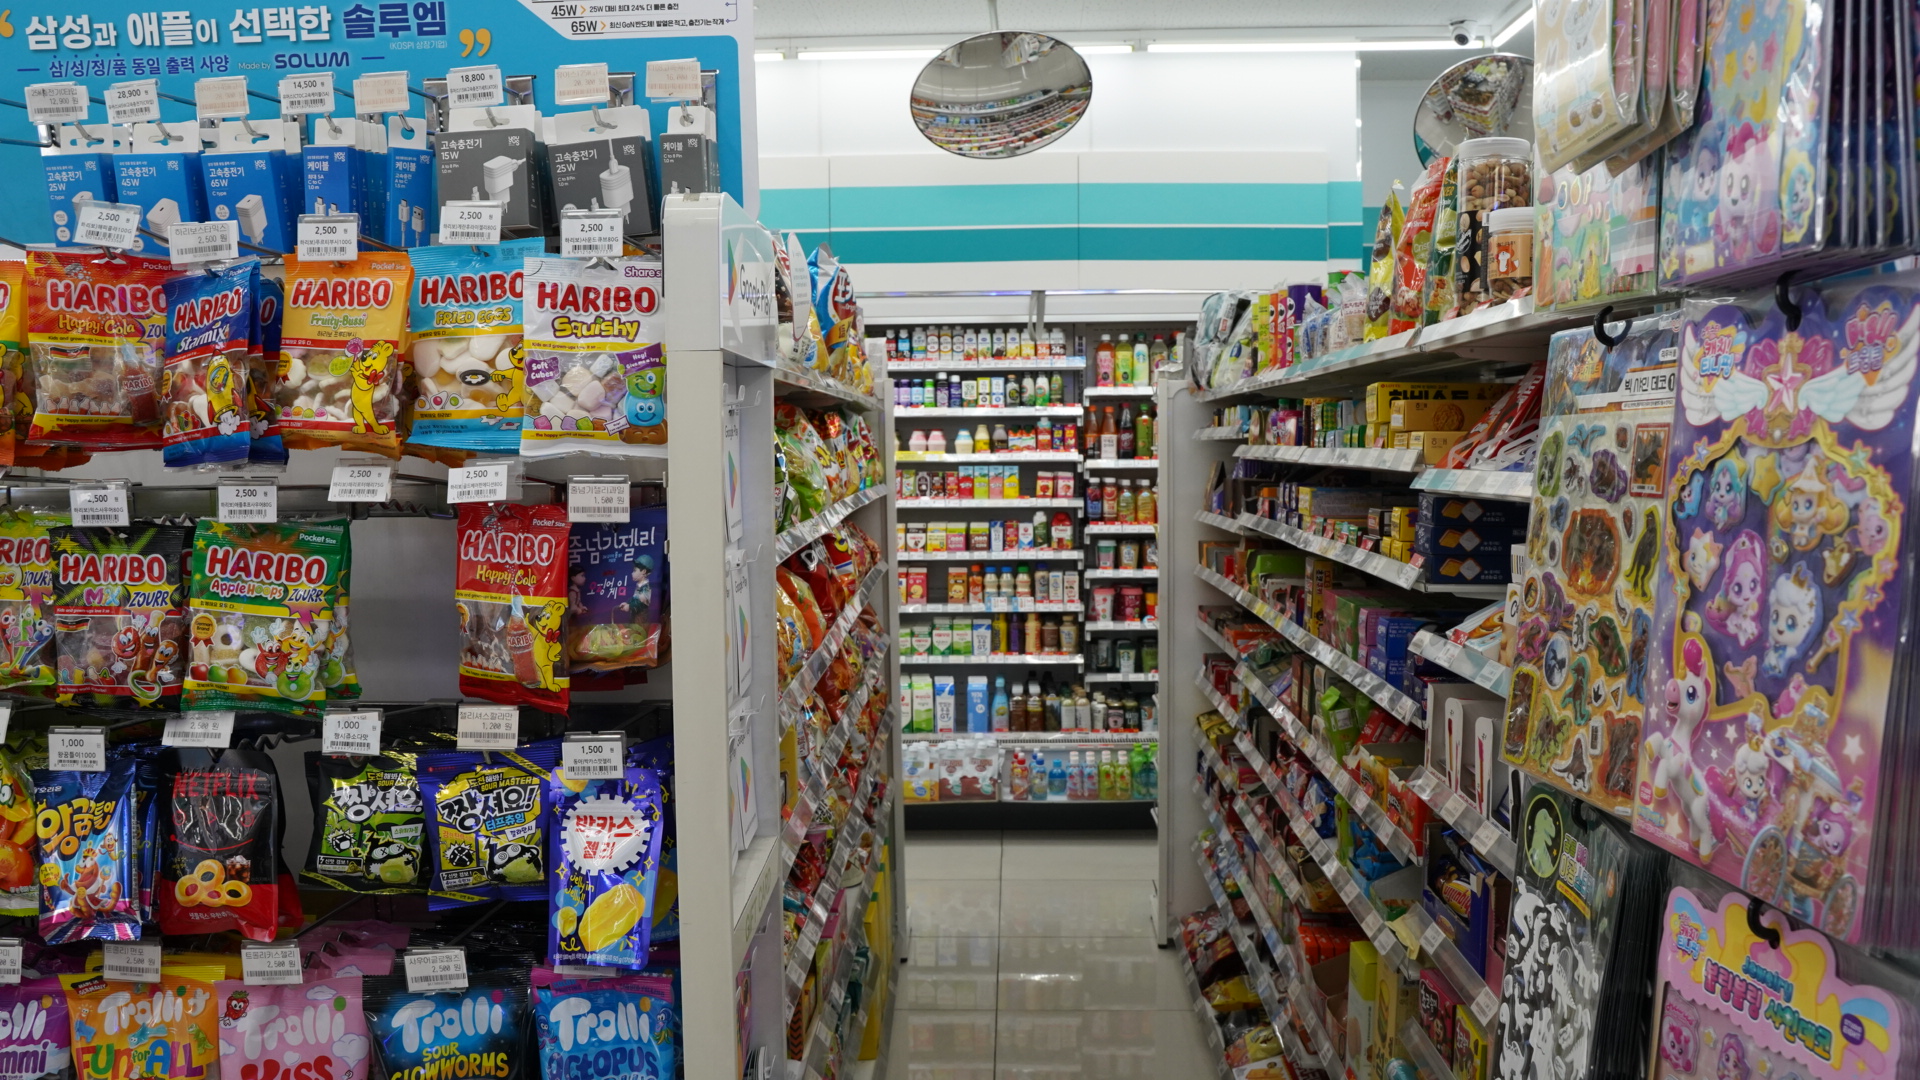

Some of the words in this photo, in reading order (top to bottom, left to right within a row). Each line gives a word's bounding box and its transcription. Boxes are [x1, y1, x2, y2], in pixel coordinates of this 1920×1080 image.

[551, 5, 577, 17] 45W
[631, 4, 645, 12] 24%
[25, 16, 117, 50] 삼성과
[126, 10, 218, 46] 애플이
[229, 6, 332, 43] 선택한
[343, 2, 447, 39] 솔루엠
[571, 21, 597, 33] 65W
[131, 56, 161, 75] 동일
[165, 55, 195, 75] 출력
[200, 54, 230, 73] 사양
[238, 61, 260, 70] Made
[261, 61, 271, 71] by
[275, 52, 350, 69] SOLUM
[461, 73, 486, 83] 18,800
[293, 80, 317, 90] 14,500
[117, 89, 142, 99] 28,900
[441, 138, 483, 150] 고속충전기
[663, 142, 683, 151] 케이블
[441, 151, 460, 160] 15W
[555, 149, 598, 163] 고속충전기
[120, 167, 157, 178] 고속충전기
[209, 167, 245, 177] 고속충전기
[307, 161, 330, 172] 케이블
[395, 162, 416, 172] 케이블
[556, 163, 576, 173] 25W
[47, 171, 83, 182] 고속충전기
[48, 183, 66, 191] 25W
[121, 179, 140, 187] 45W
[210, 179, 229, 188] 65W
[98, 212, 120, 222] 2,500
[460, 211, 482, 220] 2,500
[175, 225, 227, 236] 하리보스타믹스
[315, 226, 337, 235] 2,500
[581, 224, 603, 233] 2,500
[197, 235, 217, 244] 2,500
[624, 266, 655, 278] Share
[291, 279, 393, 308] HARIBO
[420, 271, 524, 305] HARIBO
[48, 280, 168, 314] HARIBO
[537, 281, 656, 314] HARIBO
[173, 287, 243, 334] HARIBO
[436, 311, 475, 325] FRIED
[477, 307, 512, 324] EGGS
[58, 314, 100, 336] Happy
[104, 319, 137, 336] Cola
[311, 313, 367, 329] Fruity-Bussi
[553, 316, 640, 341] Squishy
[177, 321, 226, 353] Starmix
[531, 362, 549, 371] Soft
[1700, 354, 1734, 380] 티니핑
[530, 371, 554, 380] Cubes
[349, 469, 372, 479] 2,500
[466, 469, 488, 479] 2,500
[87, 494, 108, 503] 2,500
[235, 489, 257, 498] 2,500
[532, 518, 554, 526] Pocket
[299, 533, 325, 543] Pocket
[460, 530, 556, 567] HARIBO
[60, 555, 166, 584] HARIBO
[207, 547, 326, 585] HARIBO
[476, 565, 511, 586] Happy
[514, 569, 538, 587] Cola
[129, 590, 171, 608] ZOURR
[287, 588, 325, 603] ZOURR
[337, 720, 360, 730] 1,000
[61, 738, 85, 747] 1,000
[581, 745, 604, 754] 1,500
[172, 771, 260, 801] NETFLIX
[481, 782, 497, 792] SOUR
[498, 776, 533, 788] MASTER
[37, 797, 116, 855] 왕꿈틀이
[575, 814, 635, 839] 박카스
[78, 984, 107, 996] GERMANY
[97, 990, 183, 1035] Trolli
[391, 995, 502, 1053] Trolli
[549, 996, 650, 1051] Trolli
[236, 1003, 346, 1060] Trolli
[422, 1043, 460, 1060] SOUR
[131, 1050, 151, 1063] for
[146, 1039, 204, 1079] ALL
